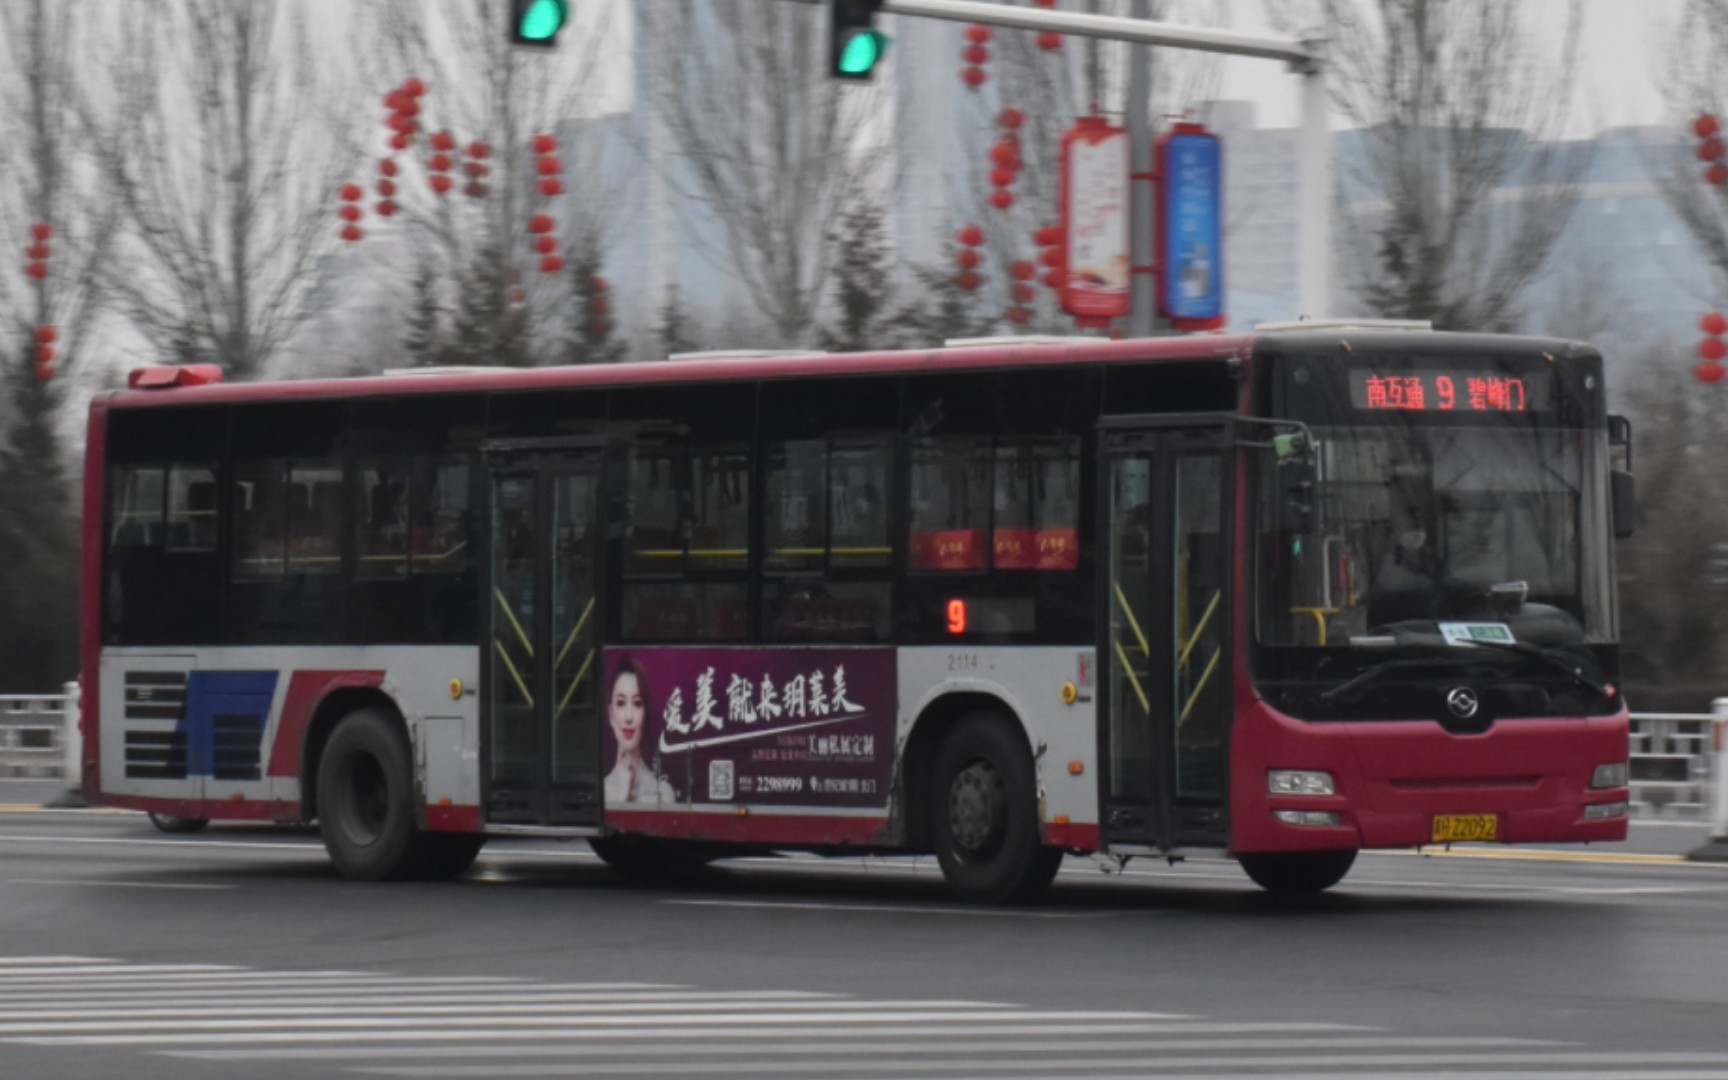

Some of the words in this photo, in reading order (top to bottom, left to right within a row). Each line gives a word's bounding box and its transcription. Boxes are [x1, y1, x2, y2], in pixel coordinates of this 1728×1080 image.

[1365, 374, 1425, 409] 南互通
[1436, 375, 1456, 410] 9
[947, 599, 966, 634] 9
[947, 653, 978, 671] 2114
[756, 776, 803, 793] 2298999
